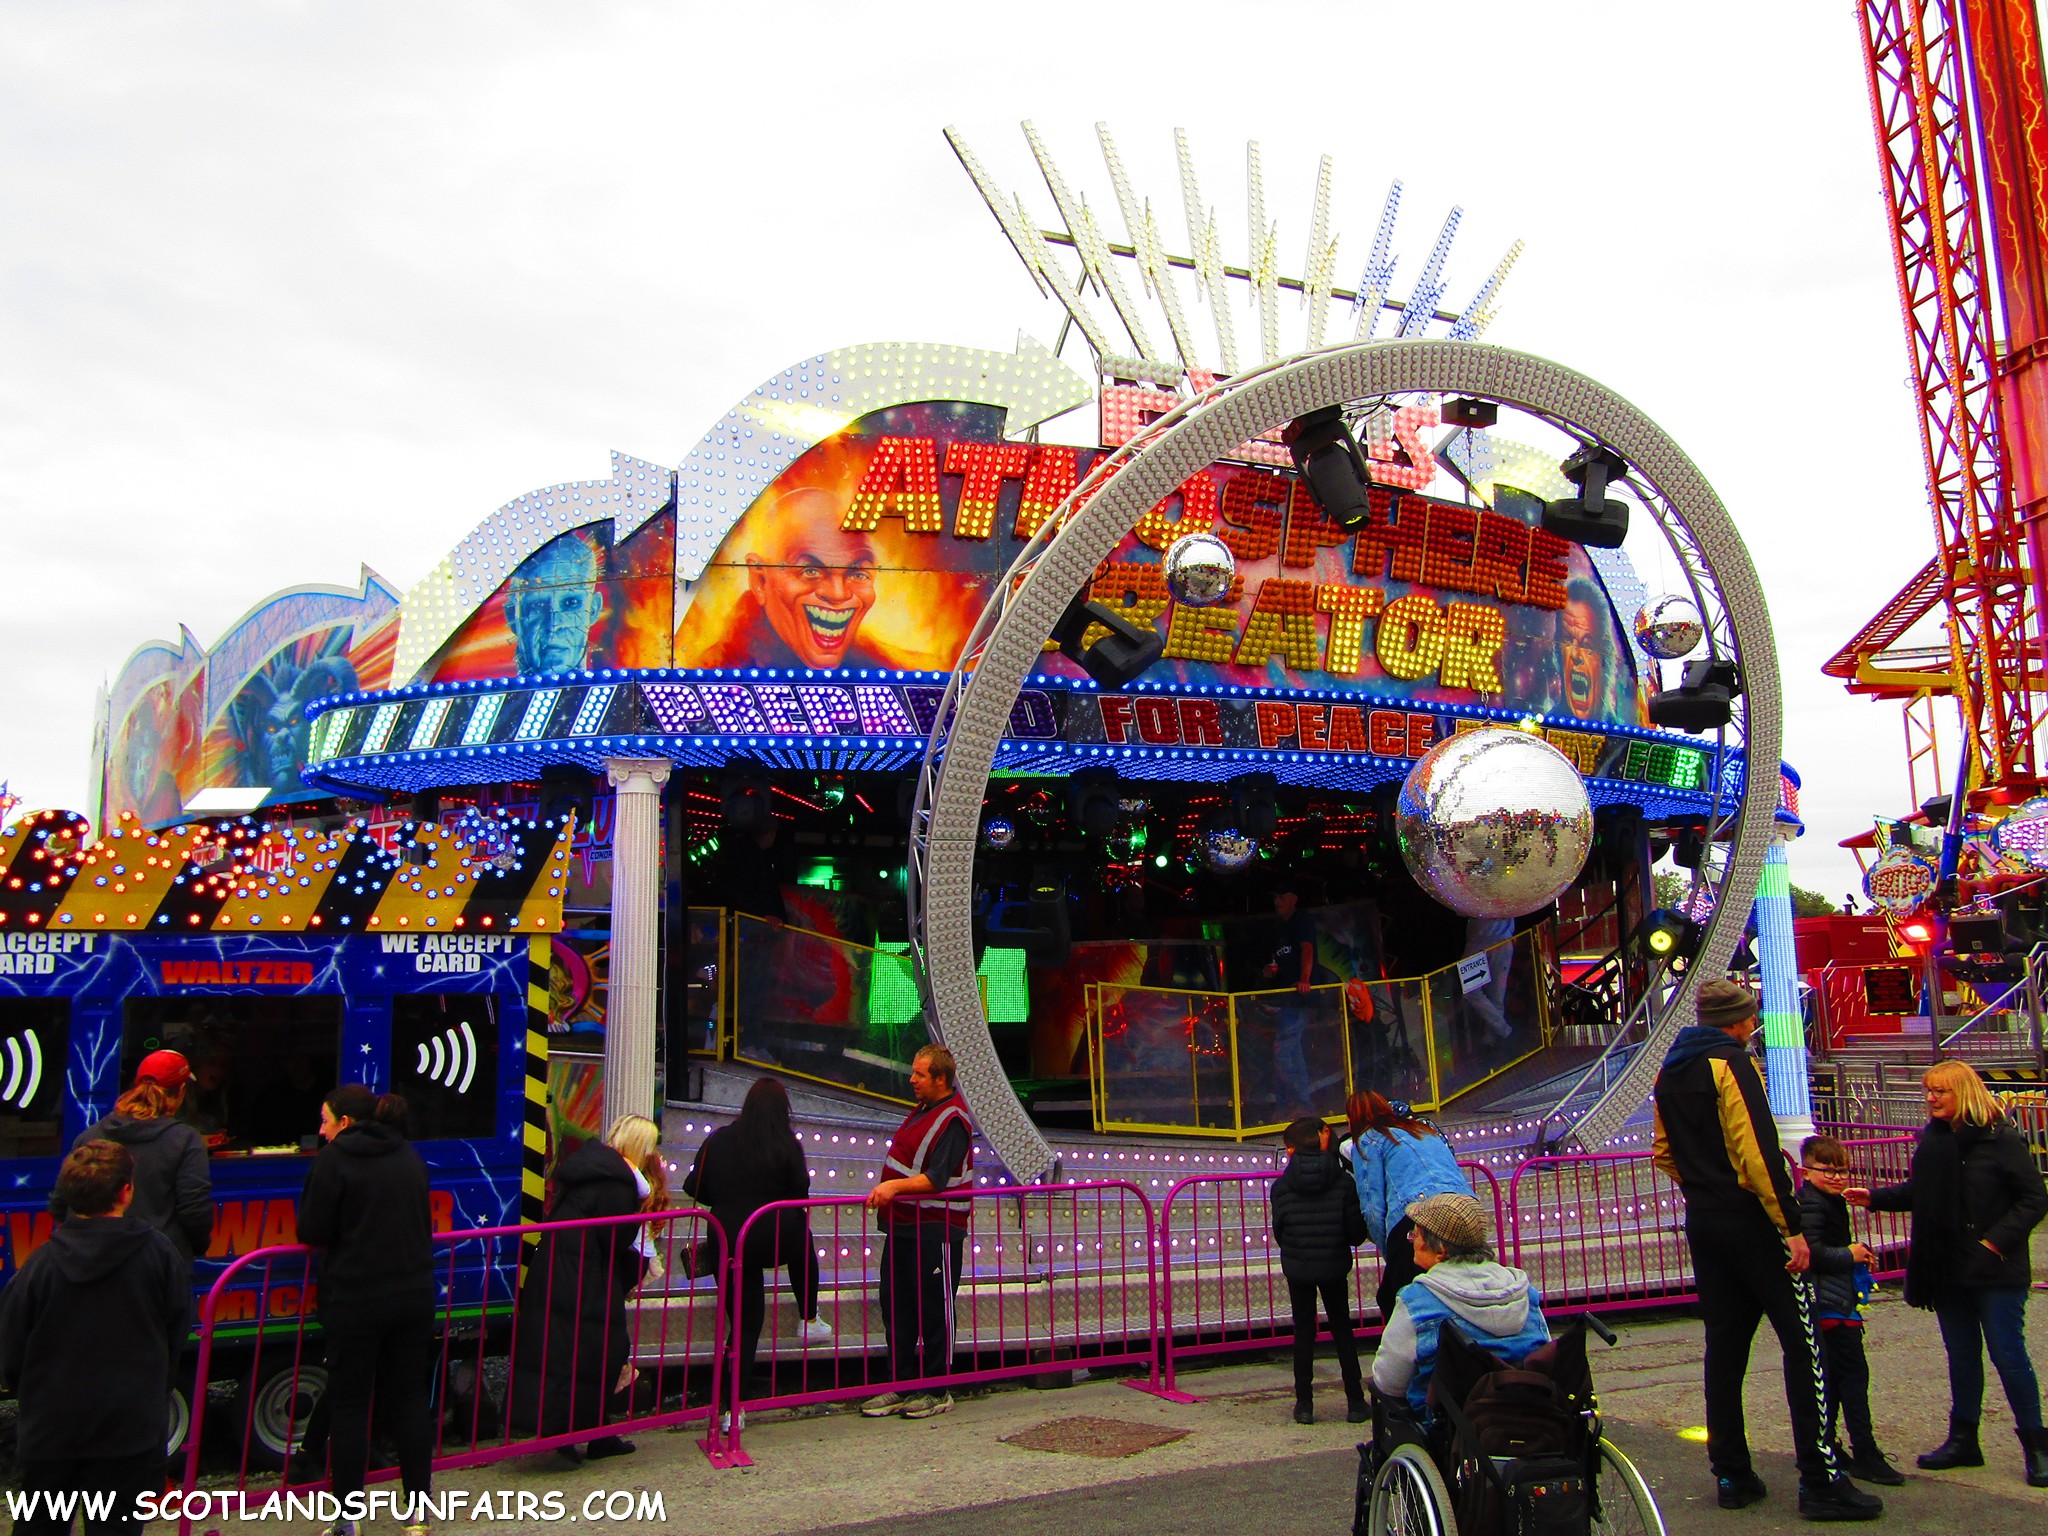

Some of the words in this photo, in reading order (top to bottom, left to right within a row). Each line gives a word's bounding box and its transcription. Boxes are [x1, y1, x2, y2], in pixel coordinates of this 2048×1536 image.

[1012, 561, 1506, 694] REATOR
[641, 683, 1058, 738] PREPARD
[1097, 695, 1226, 748] FOR
[1257, 703, 1437, 759] PEACE
[1622, 739, 1702, 789] FOR
[380, 934, 419, 953] WE
[423, 934, 516, 953] ACCEPT
[0, 954, 55, 975] ARD
[161, 960, 314, 985] WALTZER
[415, 953, 482, 973] CARD
[1459, 957, 1487, 975] ENTRANCE
